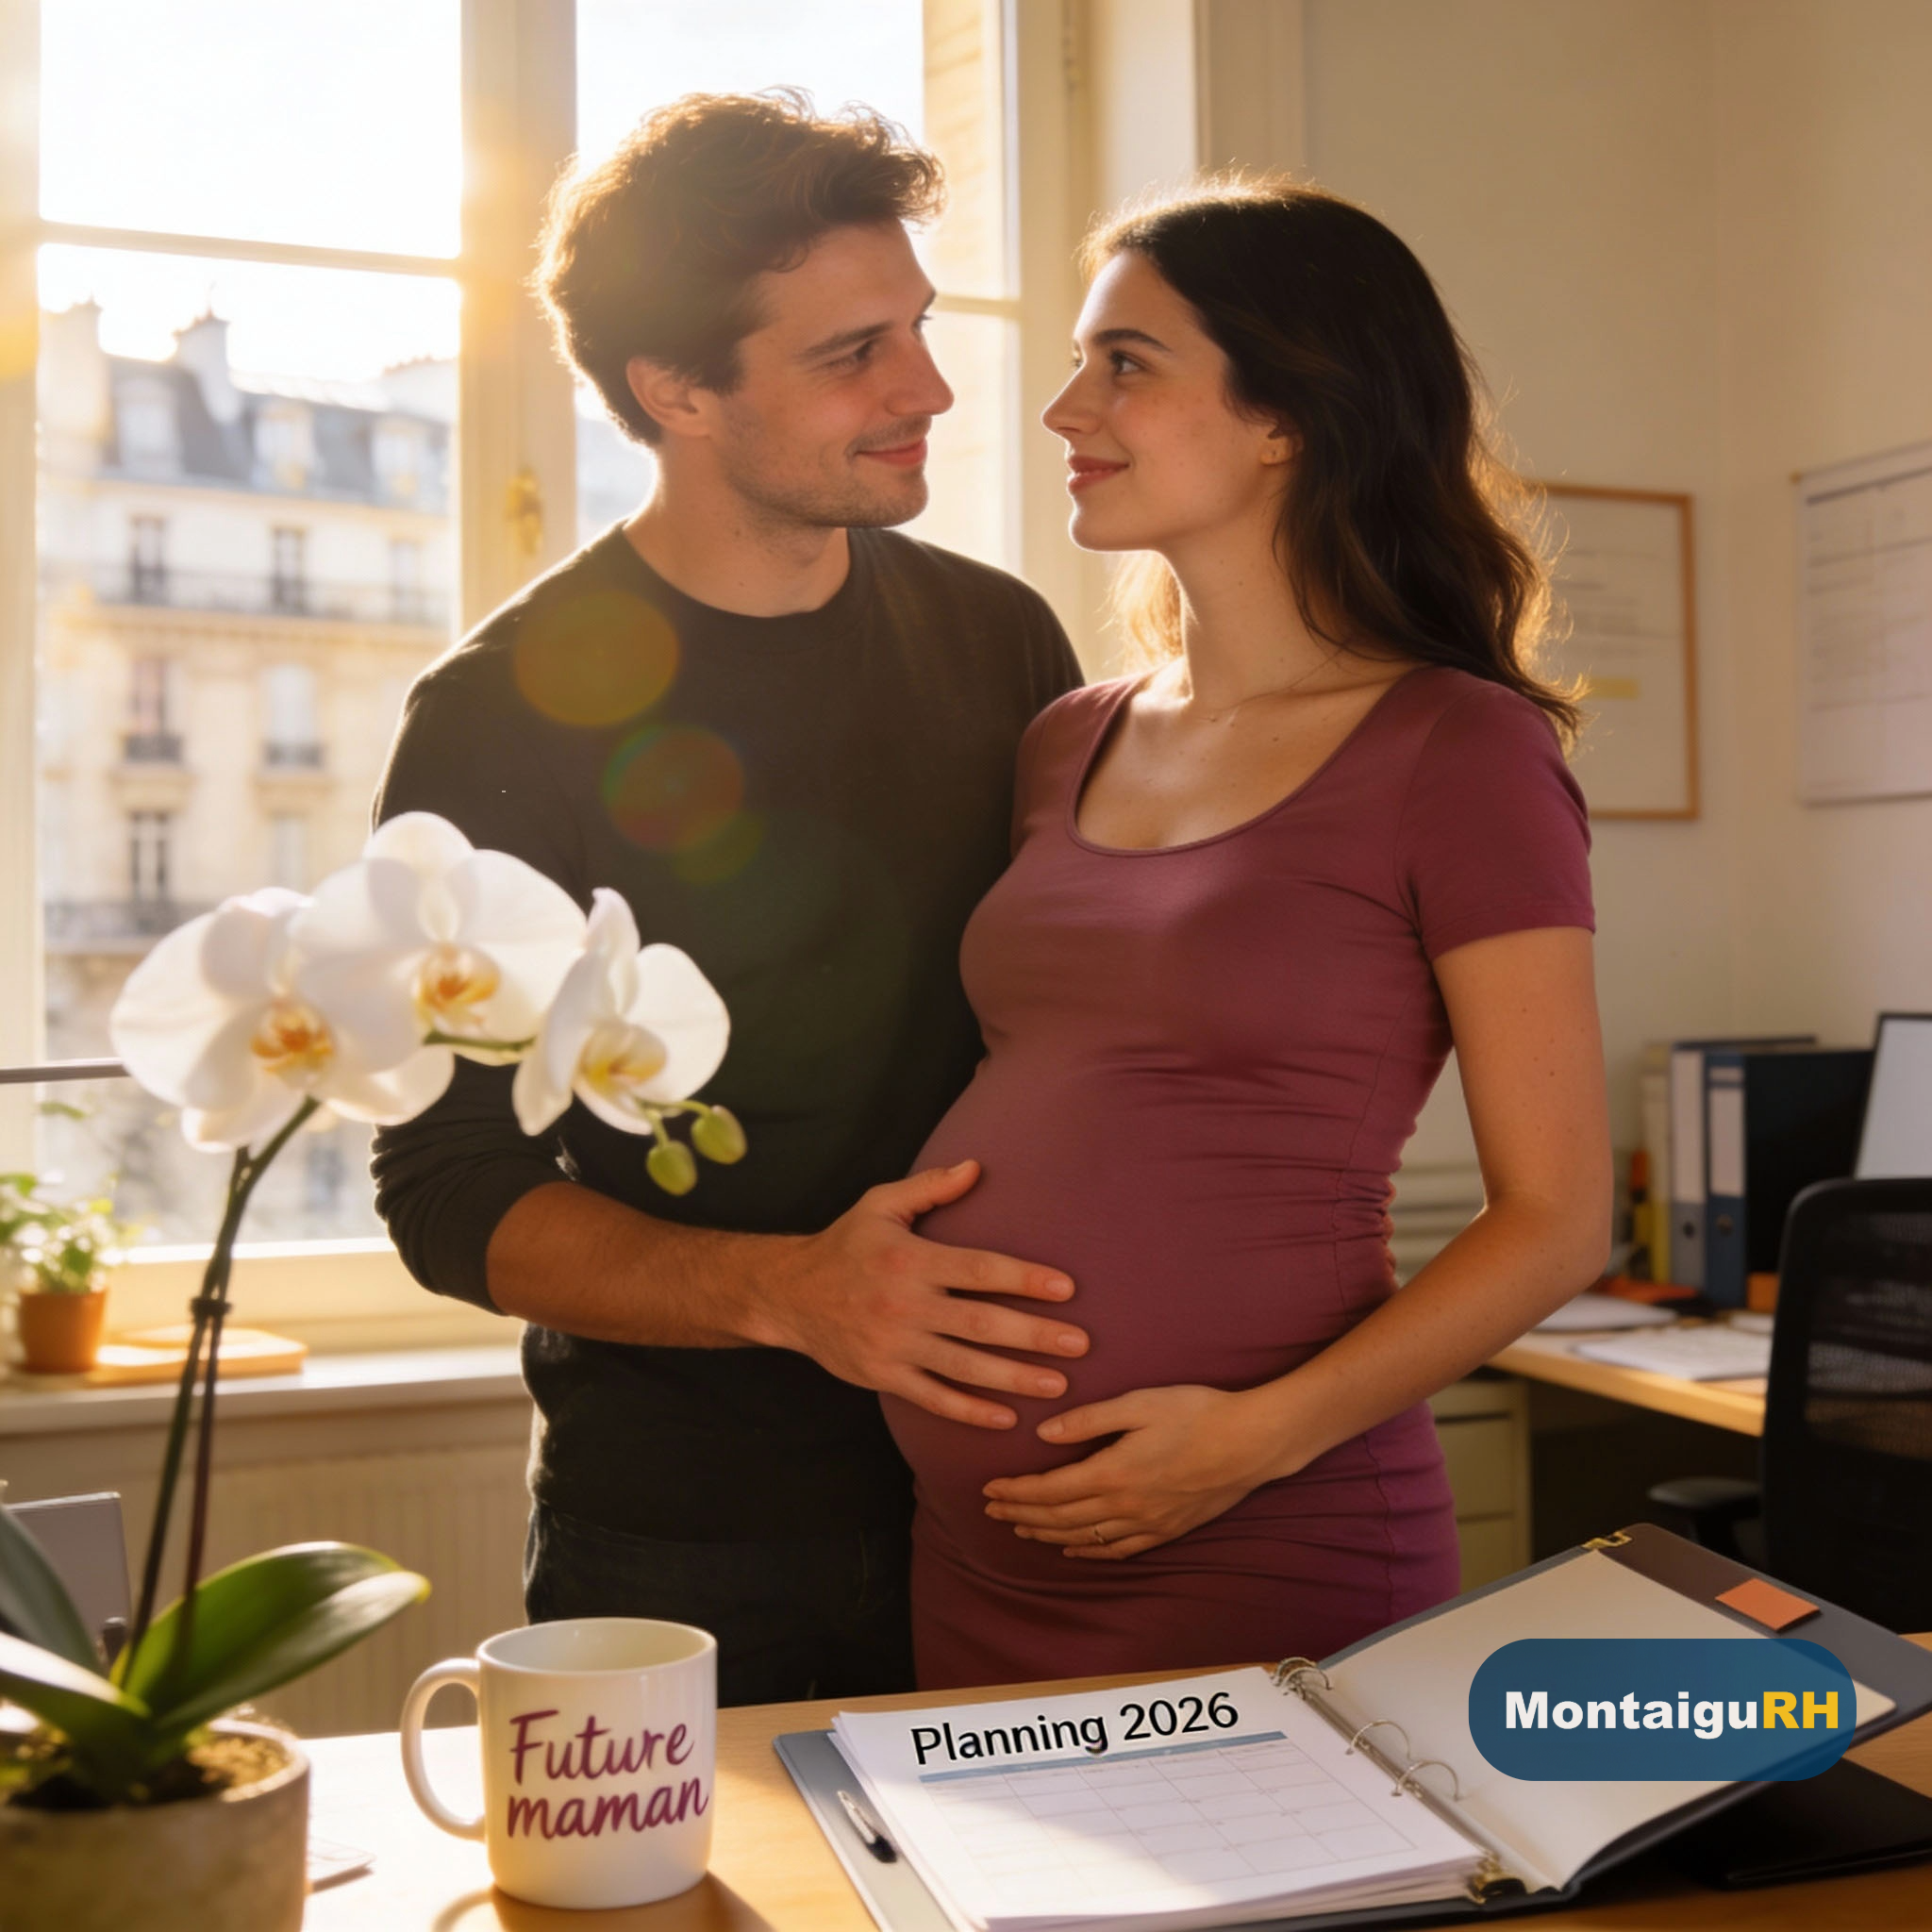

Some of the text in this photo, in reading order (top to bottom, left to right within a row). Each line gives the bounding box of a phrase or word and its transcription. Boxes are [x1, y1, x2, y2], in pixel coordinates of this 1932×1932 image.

[509, 1709, 694, 1785] Future
[910, 1714, 1108, 1765] Planning
[1120, 1691, 1239, 1740] 2026
[508, 1777, 708, 1840] maman
